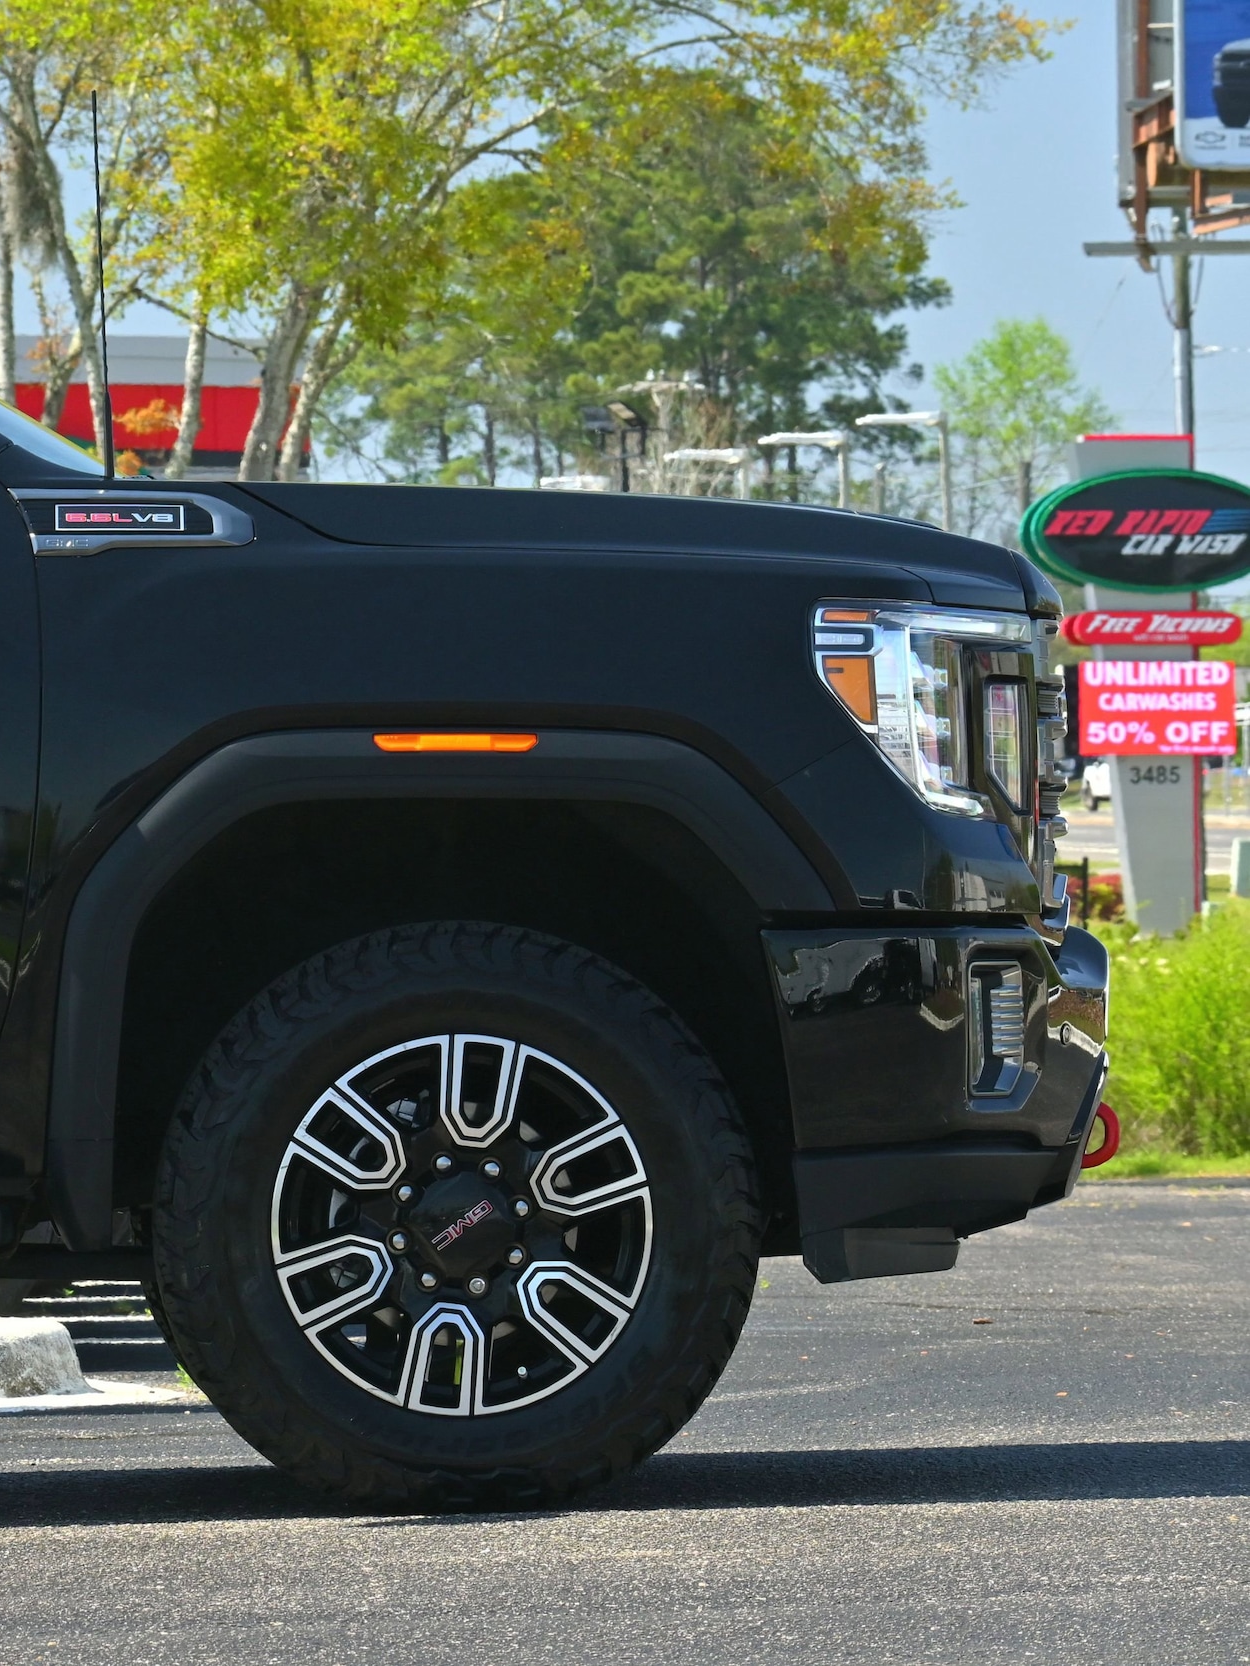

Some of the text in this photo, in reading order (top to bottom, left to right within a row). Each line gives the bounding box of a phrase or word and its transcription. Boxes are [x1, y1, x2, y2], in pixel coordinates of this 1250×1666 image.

[1044, 510, 1212, 536] RED RAPID
[1121, 533, 1247, 556] CAR WASH
[1084, 660, 1231, 687] UNLIMITED
[1098, 691, 1218, 712] CARWASHES
[1086, 721, 1230, 745] 50% OFF
[1129, 765, 1181, 785] 3485
[431, 1199, 494, 1251] GMC
